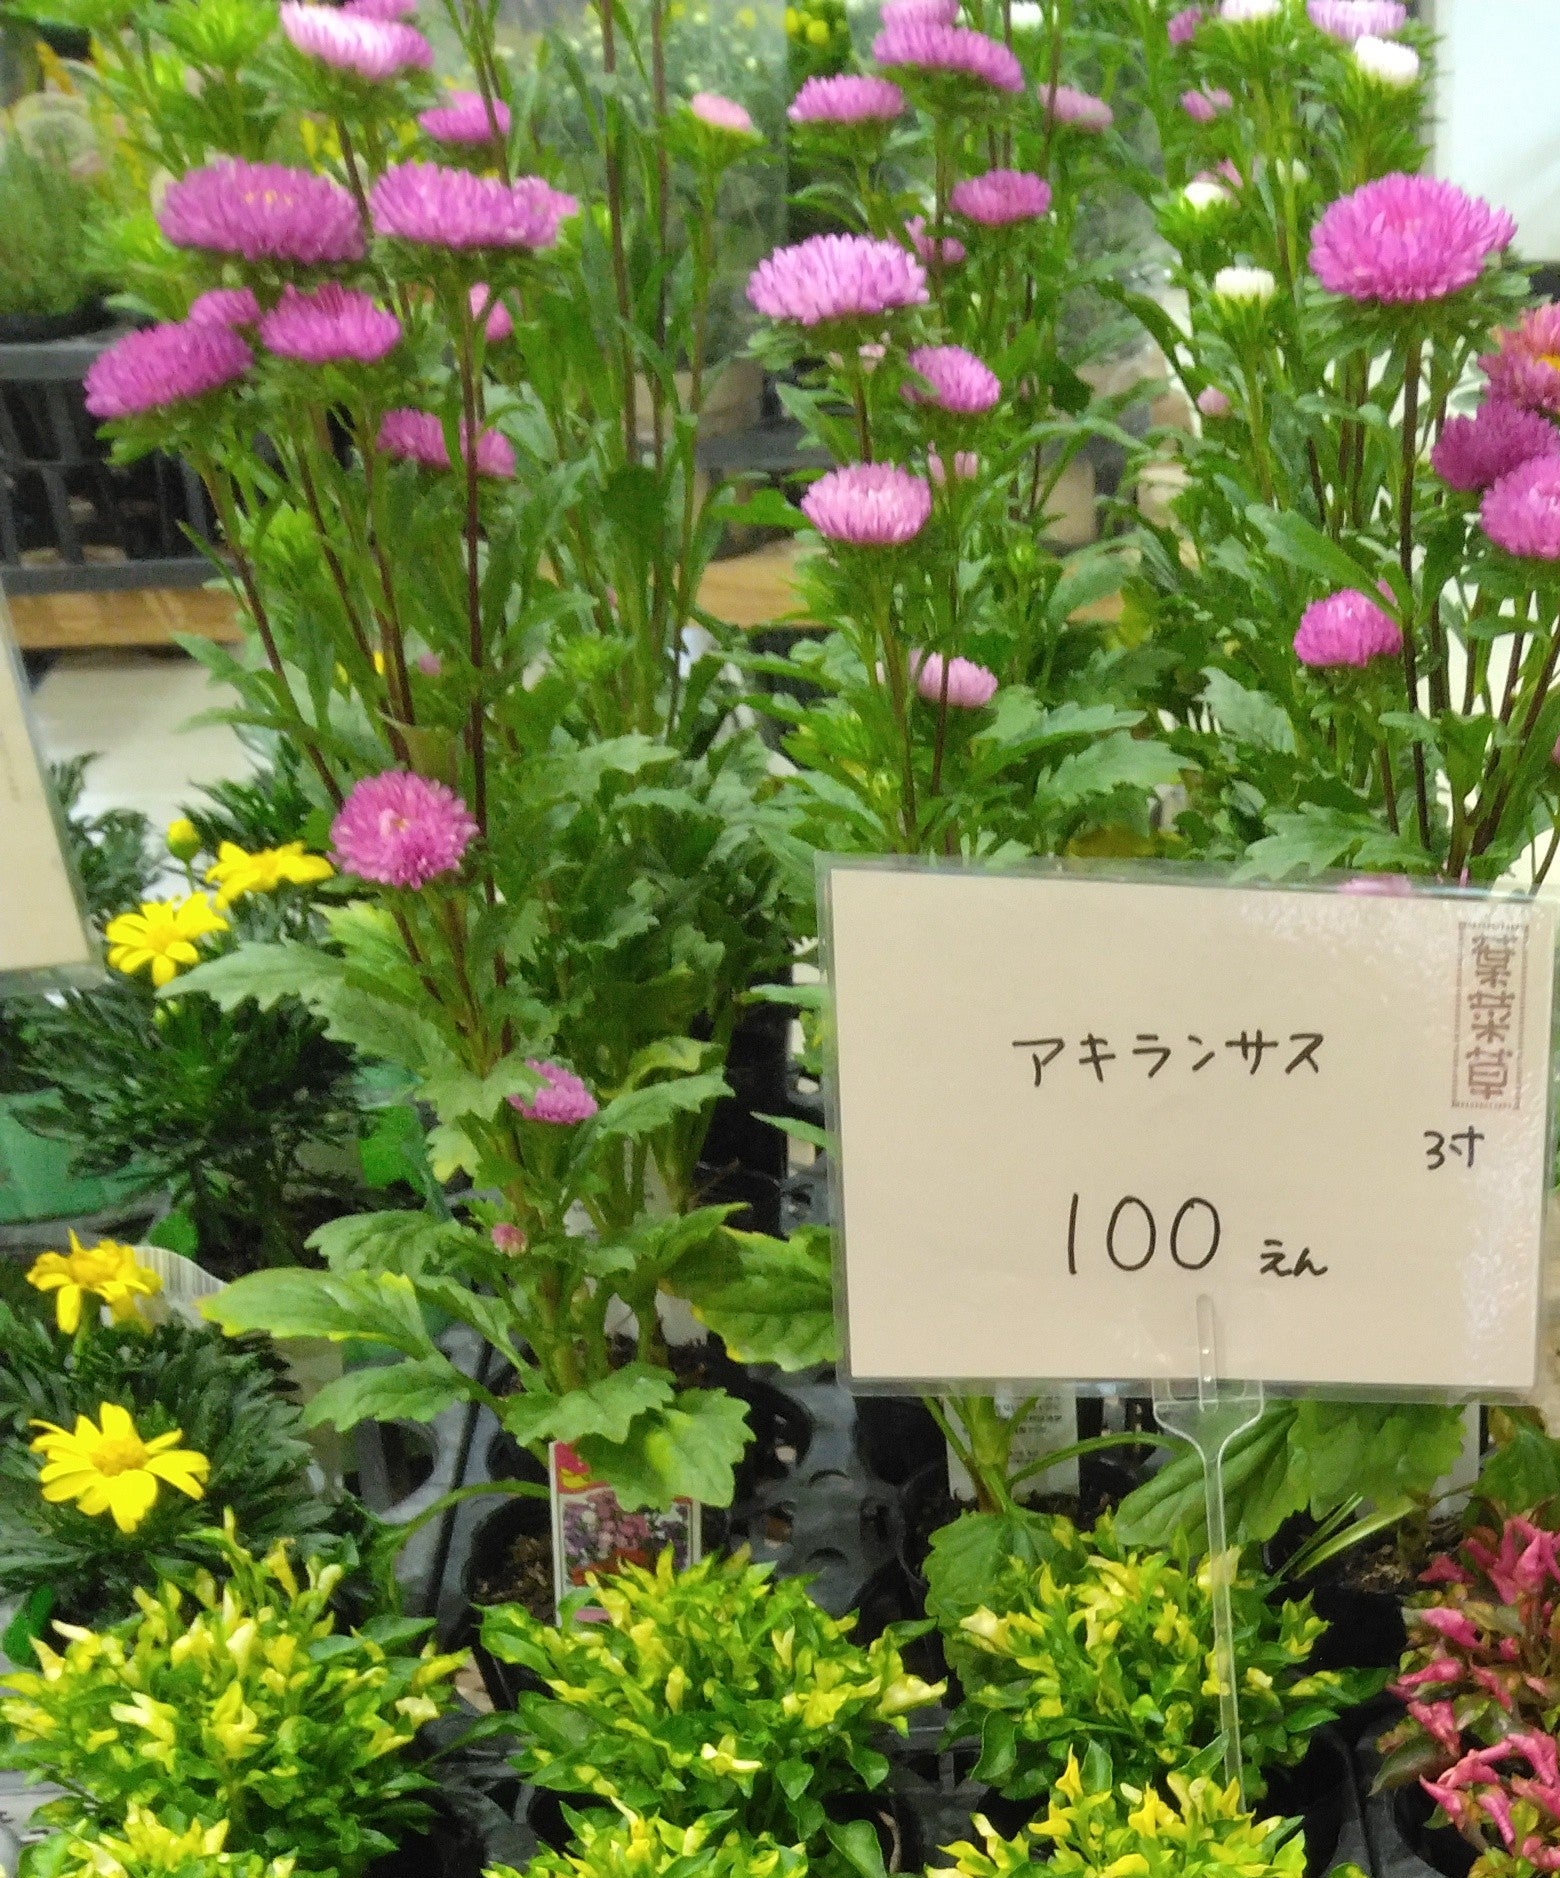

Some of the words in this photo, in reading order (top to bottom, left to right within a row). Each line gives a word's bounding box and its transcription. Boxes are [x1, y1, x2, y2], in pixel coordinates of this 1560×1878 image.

[1011, 1030, 1325, 1088] アキランサス
[1424, 1125, 1486, 1170] 3寸
[1067, 1193, 1221, 1276] 100
[1259, 1238, 1330, 1278] えん
